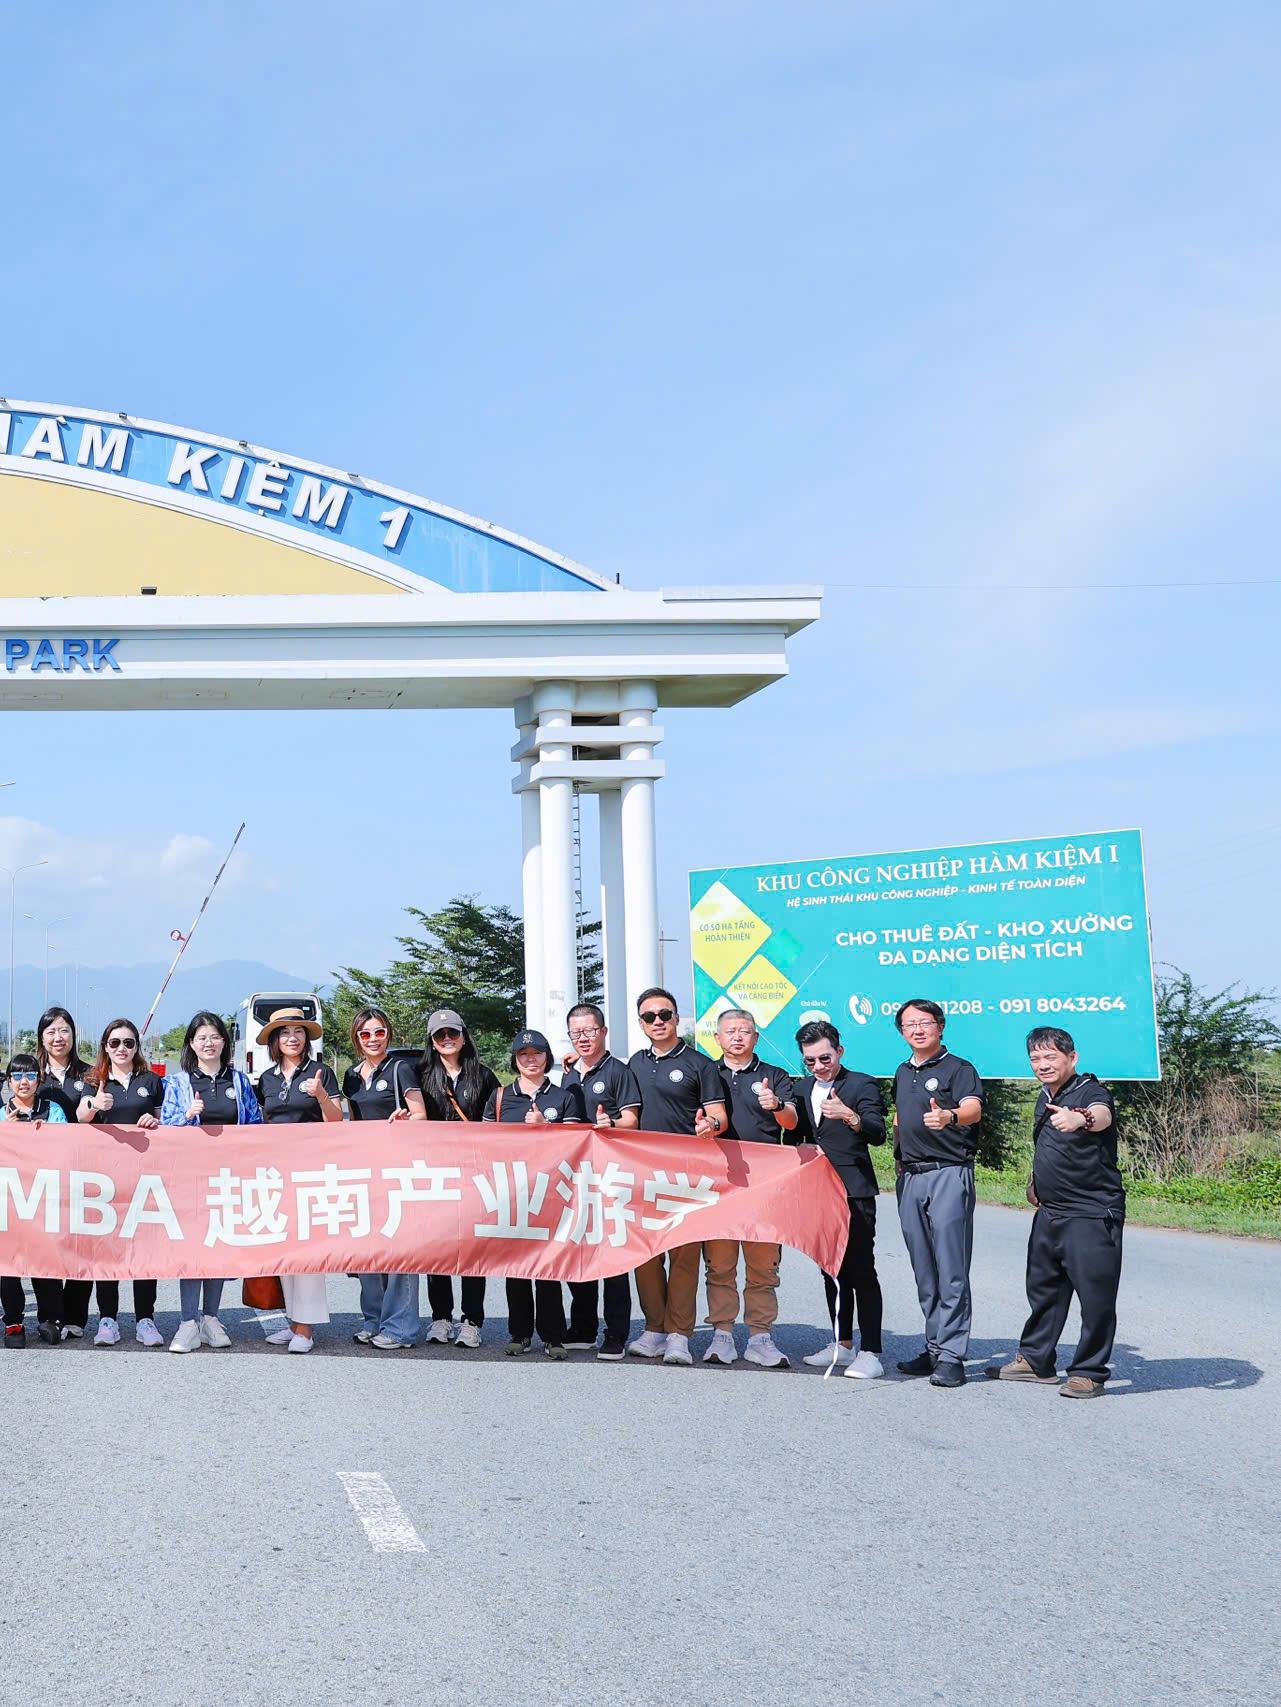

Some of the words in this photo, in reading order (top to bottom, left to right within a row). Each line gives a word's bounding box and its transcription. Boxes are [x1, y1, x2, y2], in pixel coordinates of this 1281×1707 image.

[166, 442, 353, 529] KIỆM
[378, 506, 412, 550] 1
[5, 639, 122, 671] PARK
[757, 873, 801, 892] KHU
[807, 866, 870, 888] CÔNG
[877, 855, 963, 882] NGHIỆP
[969, 851, 1028, 875] HÀM
[1034, 843, 1102, 870] KIỆM
[803, 896, 827, 906] SINH
[830, 892, 853, 904] THÁI
[856, 892, 879, 903] KHU
[881, 889, 913, 901] CÔNG
[916, 885, 959, 898] NGHIỆP
[968, 882, 997, 894] KINH
[1017, 877, 1052, 890] TOÀN
[1055, 875, 1086, 888] DIỆN
[836, 930, 877, 946] CHO
[881, 924, 934, 944] THUÊ
[938, 920, 979, 942] ĐẤT
[998, 920, 1044, 938] KHO
[1050, 911, 1133, 935] XƯỞNG
[878, 949, 908, 965] ĐA
[912, 947, 970, 967] DẠNG
[976, 943, 1026, 964] DIỆN
[1035, 940, 1083, 959] TÍCH
[999, 998, 1030, 1013] 091
[1037, 995, 1126, 1012] 8043264
[203, 1159, 721, 1249] 越南产业游学
